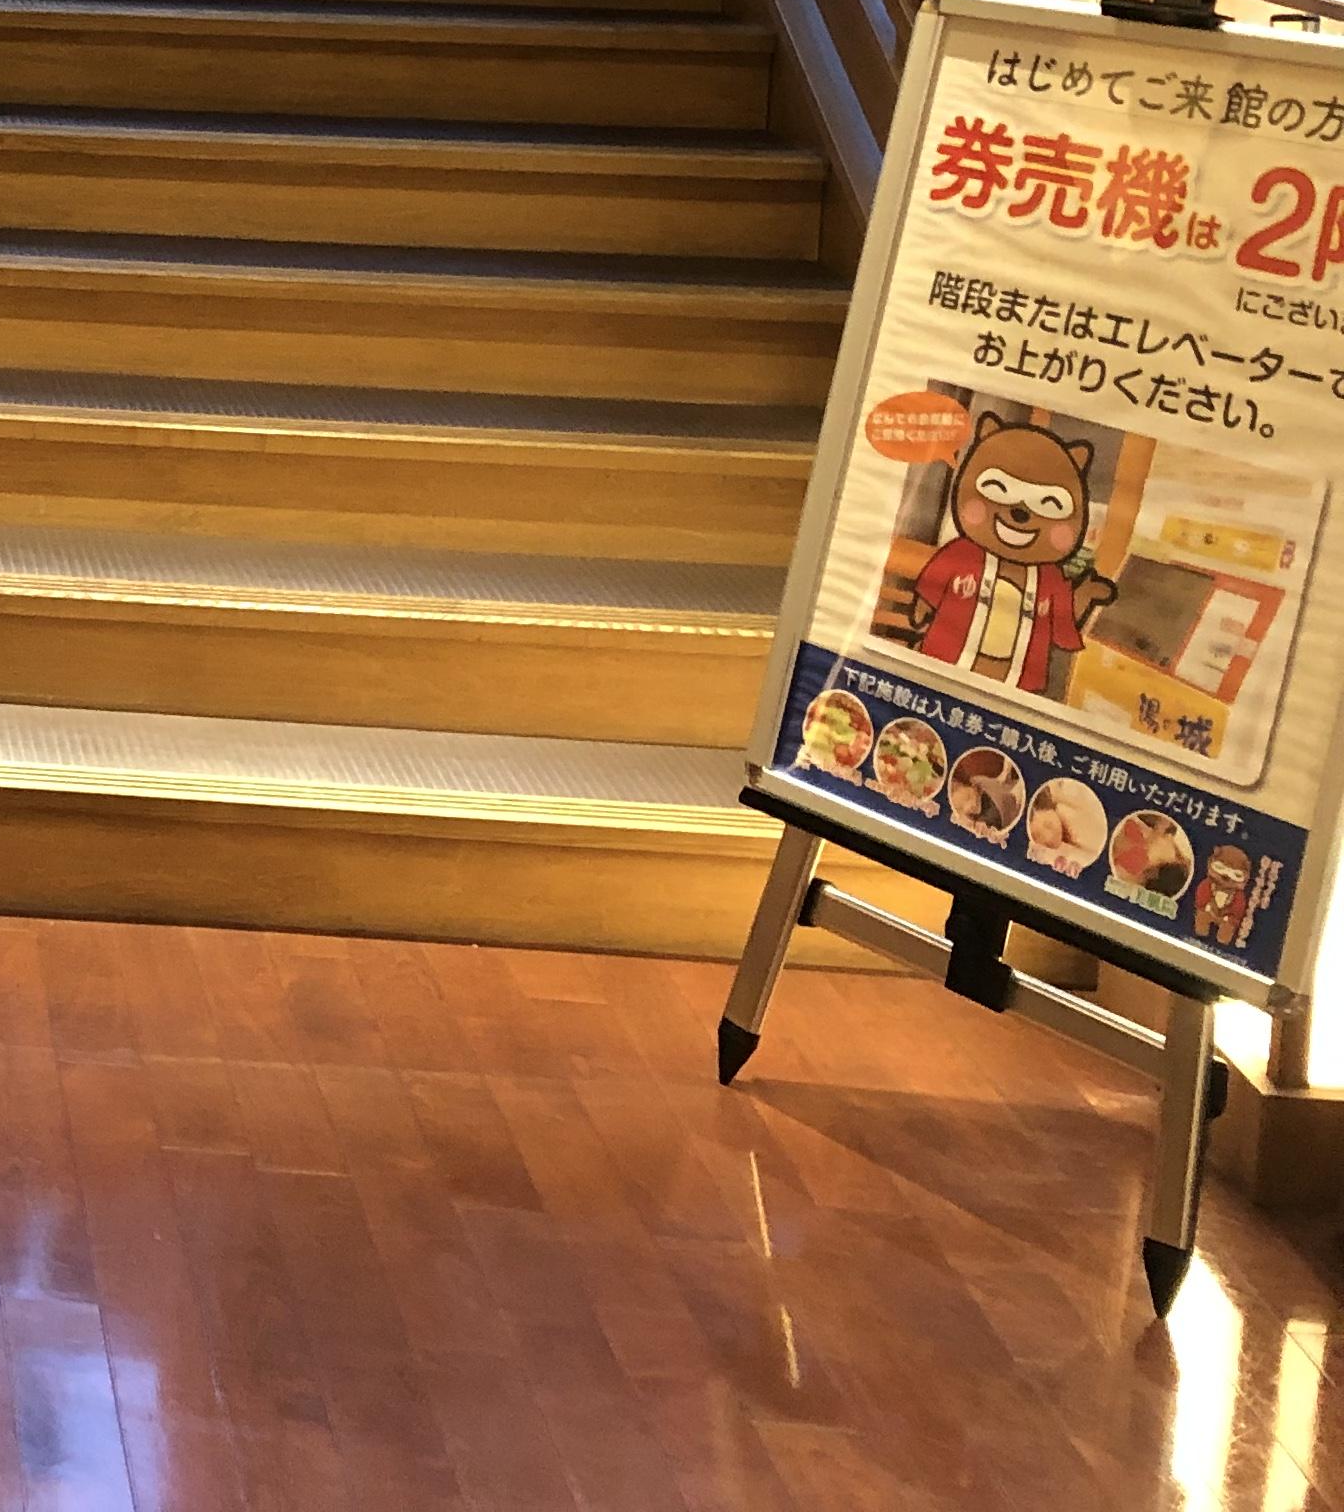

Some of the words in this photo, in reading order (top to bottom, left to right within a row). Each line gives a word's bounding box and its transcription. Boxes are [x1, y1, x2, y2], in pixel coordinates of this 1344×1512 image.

[1236, 287, 1344, 335] にござい
[973, 331, 1276, 439] お上がりください。
